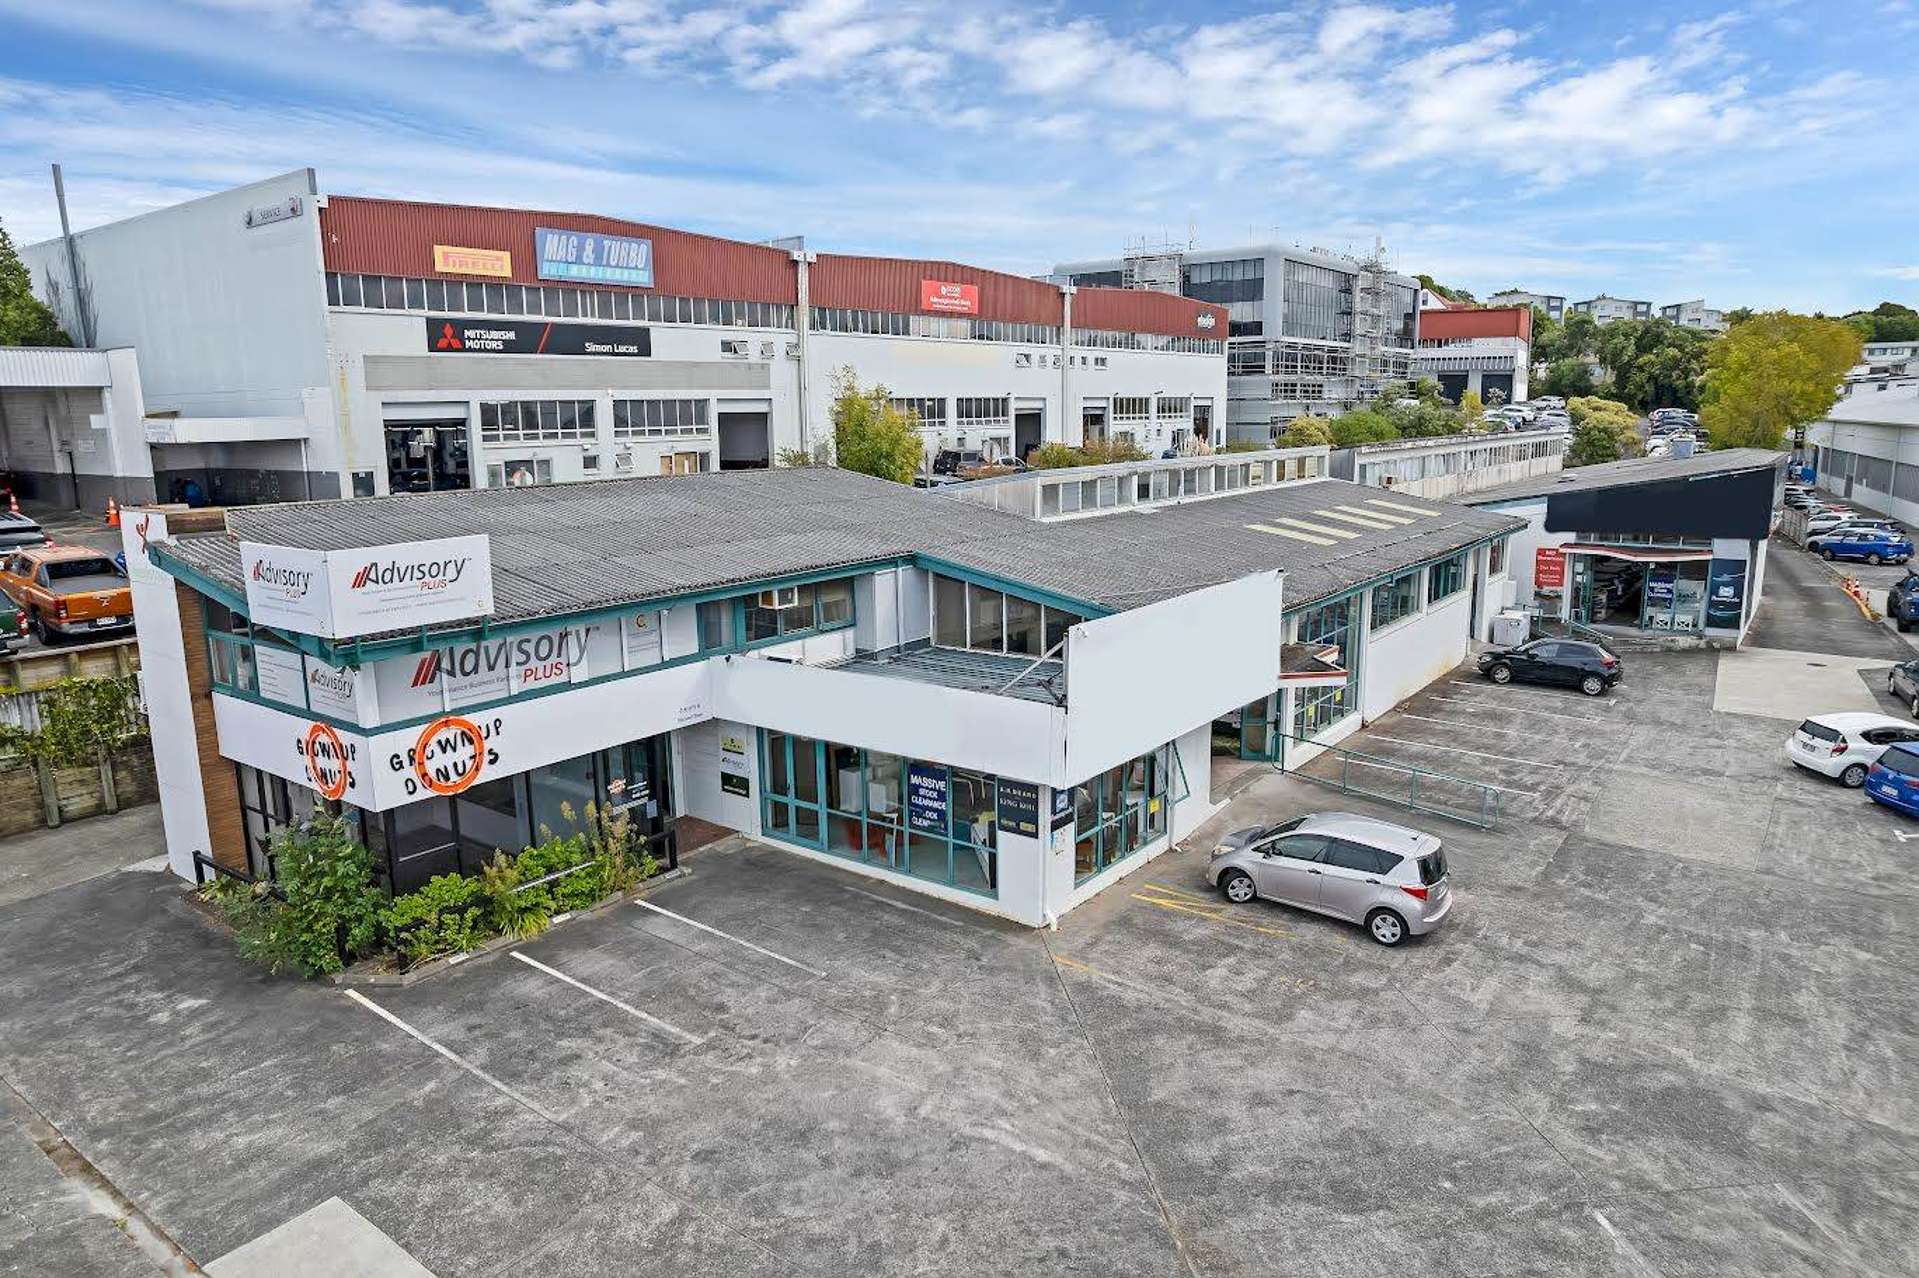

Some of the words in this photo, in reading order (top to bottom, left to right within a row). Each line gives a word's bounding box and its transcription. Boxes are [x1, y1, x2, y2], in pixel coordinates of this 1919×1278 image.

[543, 233, 578, 263] MAG
[583, 238, 595, 265] &
[602, 240, 648, 268] TURBO
[463, 329, 516, 340] MITSUBISHI
[465, 339, 504, 350] MOTORS
[584, 342, 613, 353] Simon
[614, 344, 638, 353] Lucas
[257, 559, 310, 595] Advisory
[362, 556, 467, 587] Advisory
[420, 579, 448, 591] PLUS
[429, 625, 592, 685] Advisory
[522, 661, 564, 684] PLUS
[911, 774, 947, 792] MASSIVE
[918, 787, 938, 799] STOCK
[911, 794, 946, 811] CLEARANCE
